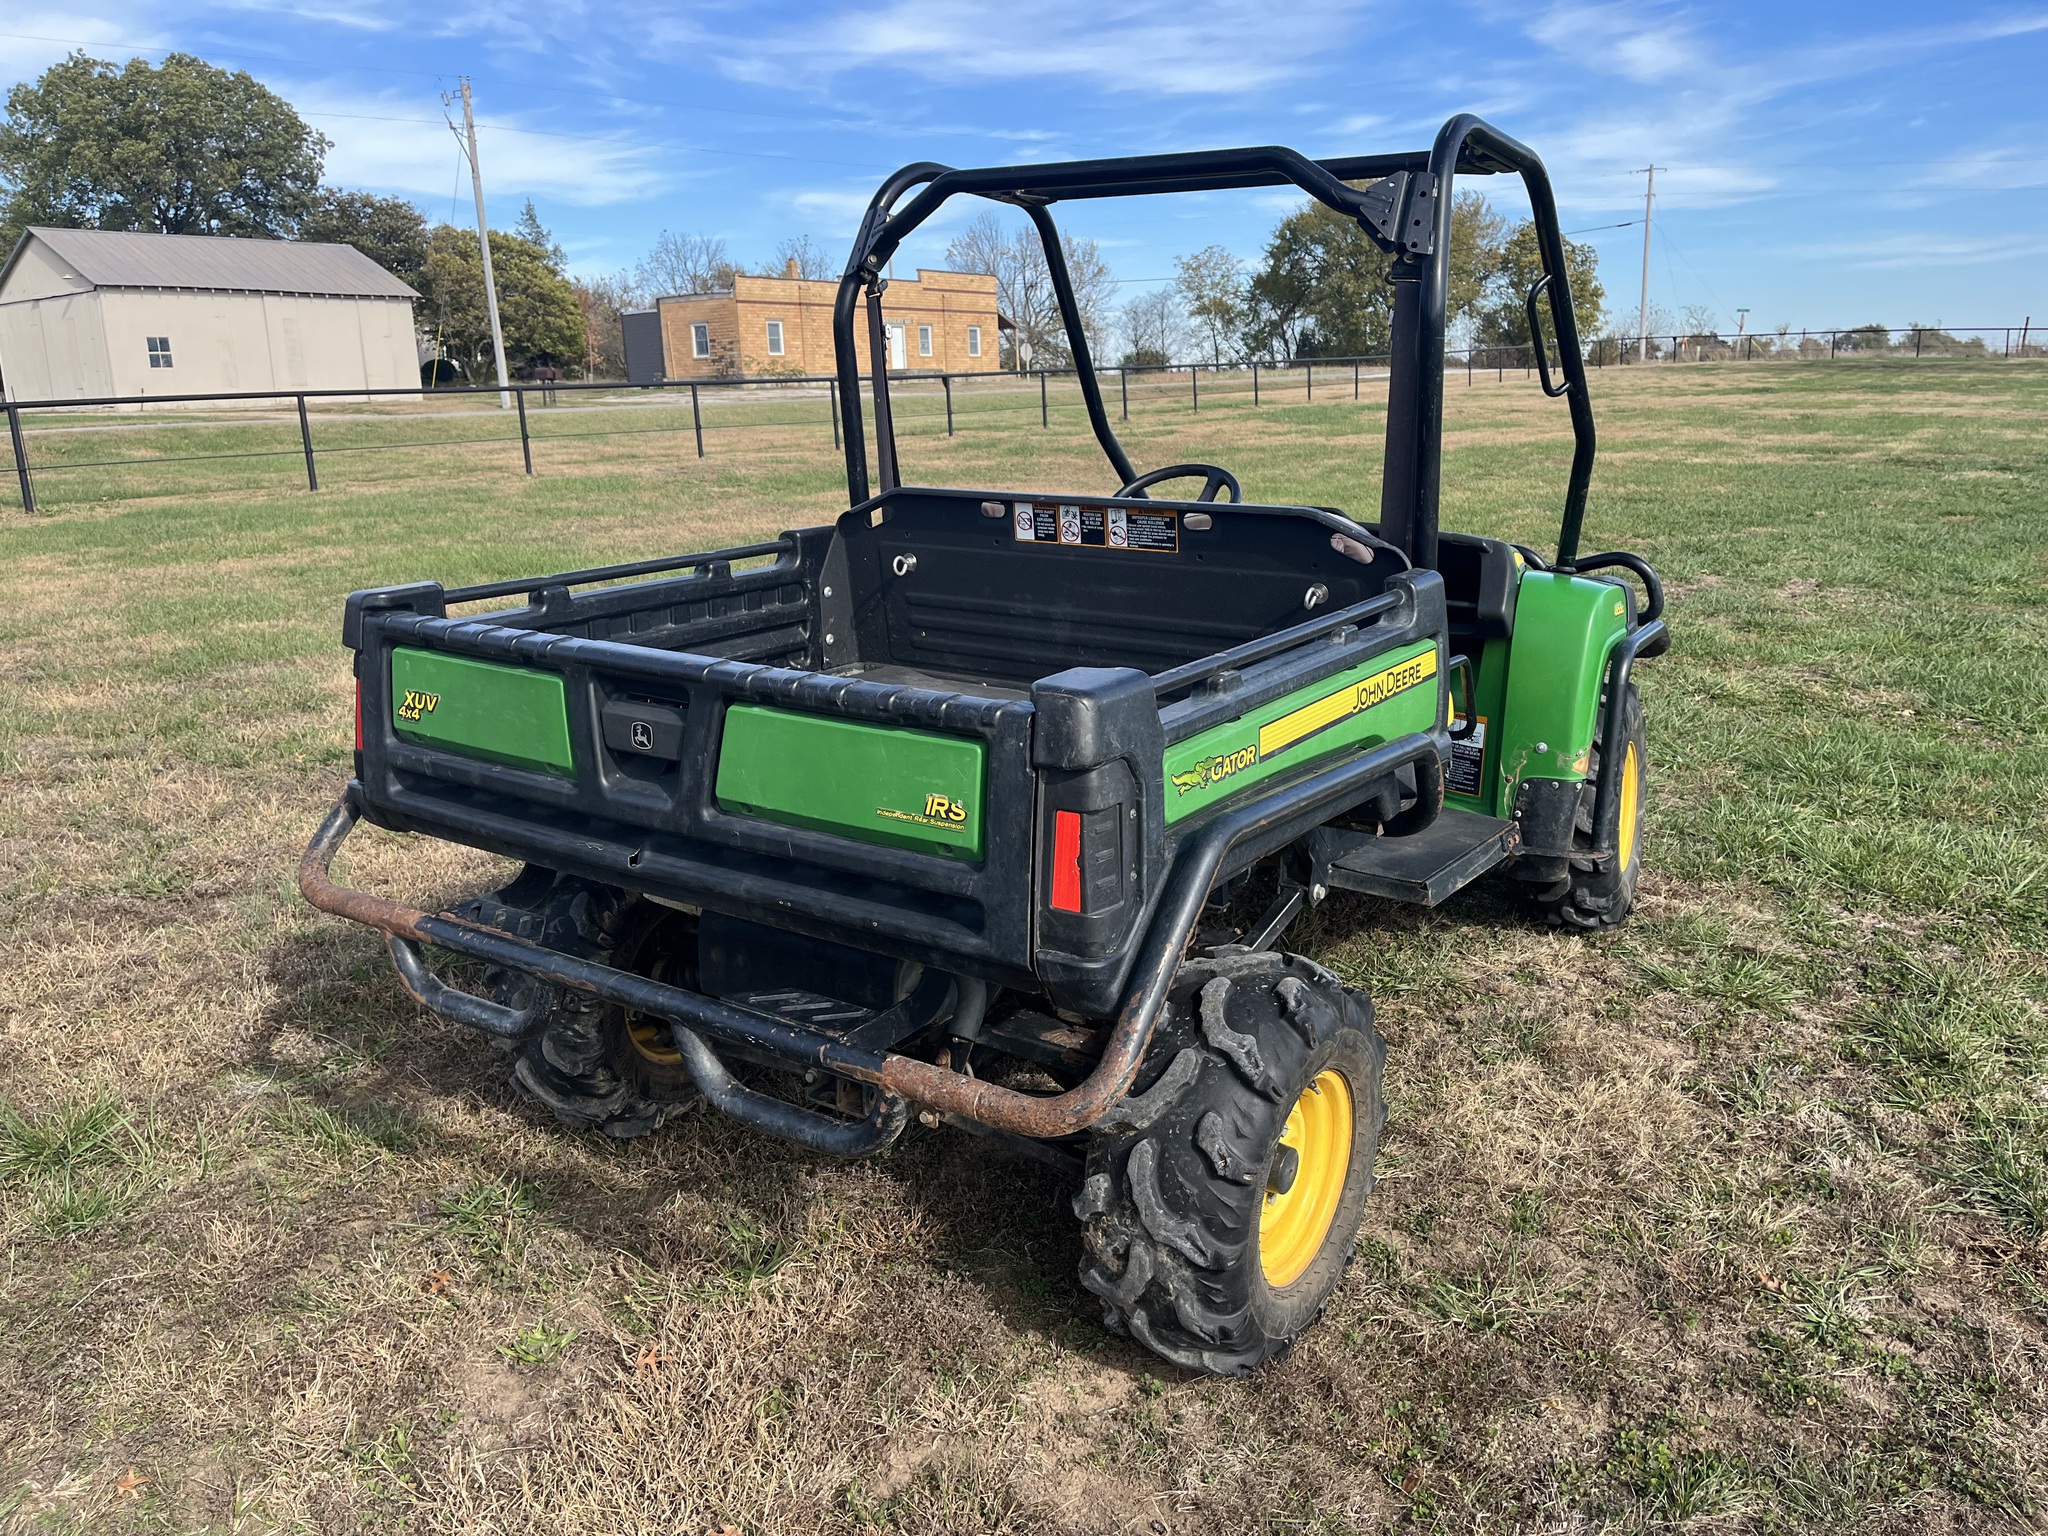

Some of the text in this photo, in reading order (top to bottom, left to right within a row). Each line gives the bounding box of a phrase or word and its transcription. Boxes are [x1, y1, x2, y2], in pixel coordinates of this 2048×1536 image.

[1353, 663, 1421, 710] JOHN DEERE
[398, 705, 420, 721] 4x4
[403, 691, 438, 712] XUV
[1210, 744, 1256, 782] GATOR
[876, 808, 965, 830] Independent Rear Suspension
[924, 796, 967, 821] IRS
